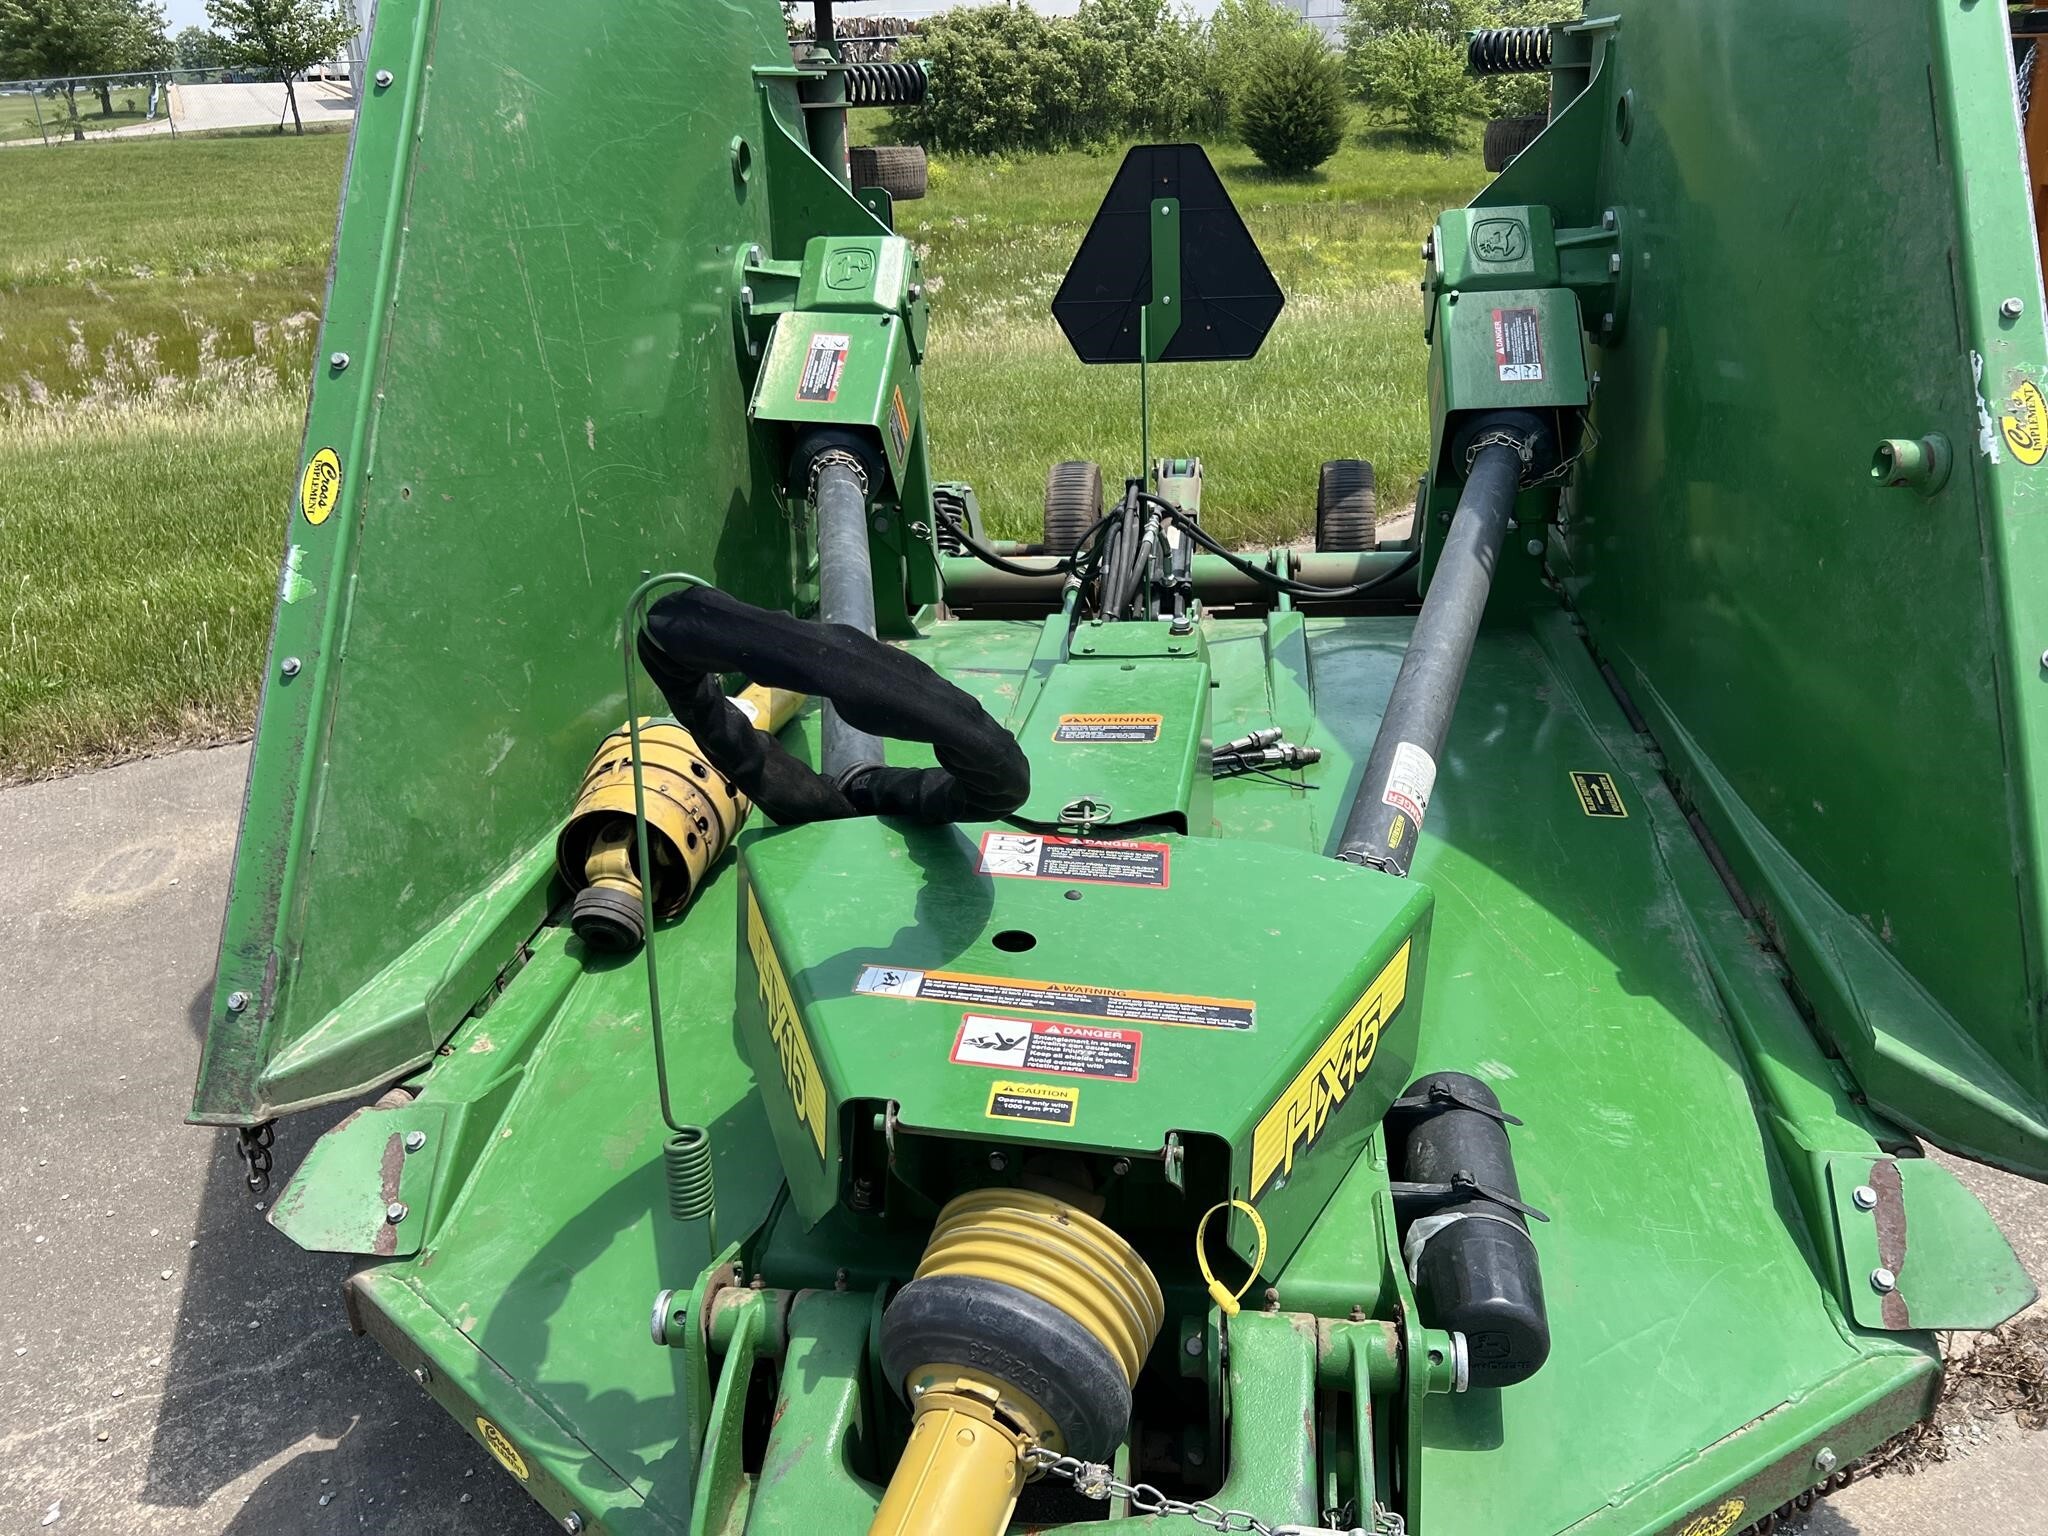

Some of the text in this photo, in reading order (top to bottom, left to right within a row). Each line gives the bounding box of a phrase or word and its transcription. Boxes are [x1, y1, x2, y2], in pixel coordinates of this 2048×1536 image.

[1494, 321, 1505, 347] DANGER
[2024, 388, 2043, 451] IMPLEMENT
[308, 459, 323, 515] IMPLEMENT
[320, 461, 338, 509] Cross
[1085, 839, 1139, 848] DANGER
[1063, 985, 1127, 997] WARNING
[759, 936, 807, 1121] HX15
[1063, 1027, 1122, 1039] DANGER
[1032, 1039, 1067, 1047] driveline
[1033, 1034, 1089, 1045] Entanglement
[1100, 1041, 1132, 1050] rotating
[1029, 1050, 1052, 1059] Keep
[1064, 1053, 1094, 1062] shields
[1104, 1056, 1130, 1065] place.
[1063, 1046, 1086, 1056] injury
[1098, 1050, 1124, 1058] death.
[1027, 1062, 1085, 1073] rotating parts.
[1053, 1059, 1085, 1067] contact
[1283, 992, 1383, 1178] HX15
[1016, 1087, 1068, 1098] CAUTION
[997, 1096, 1069, 1109] Operate only with
[1042, 1106, 1061, 1114] PTO
[485, 1424, 518, 1462] Cross
